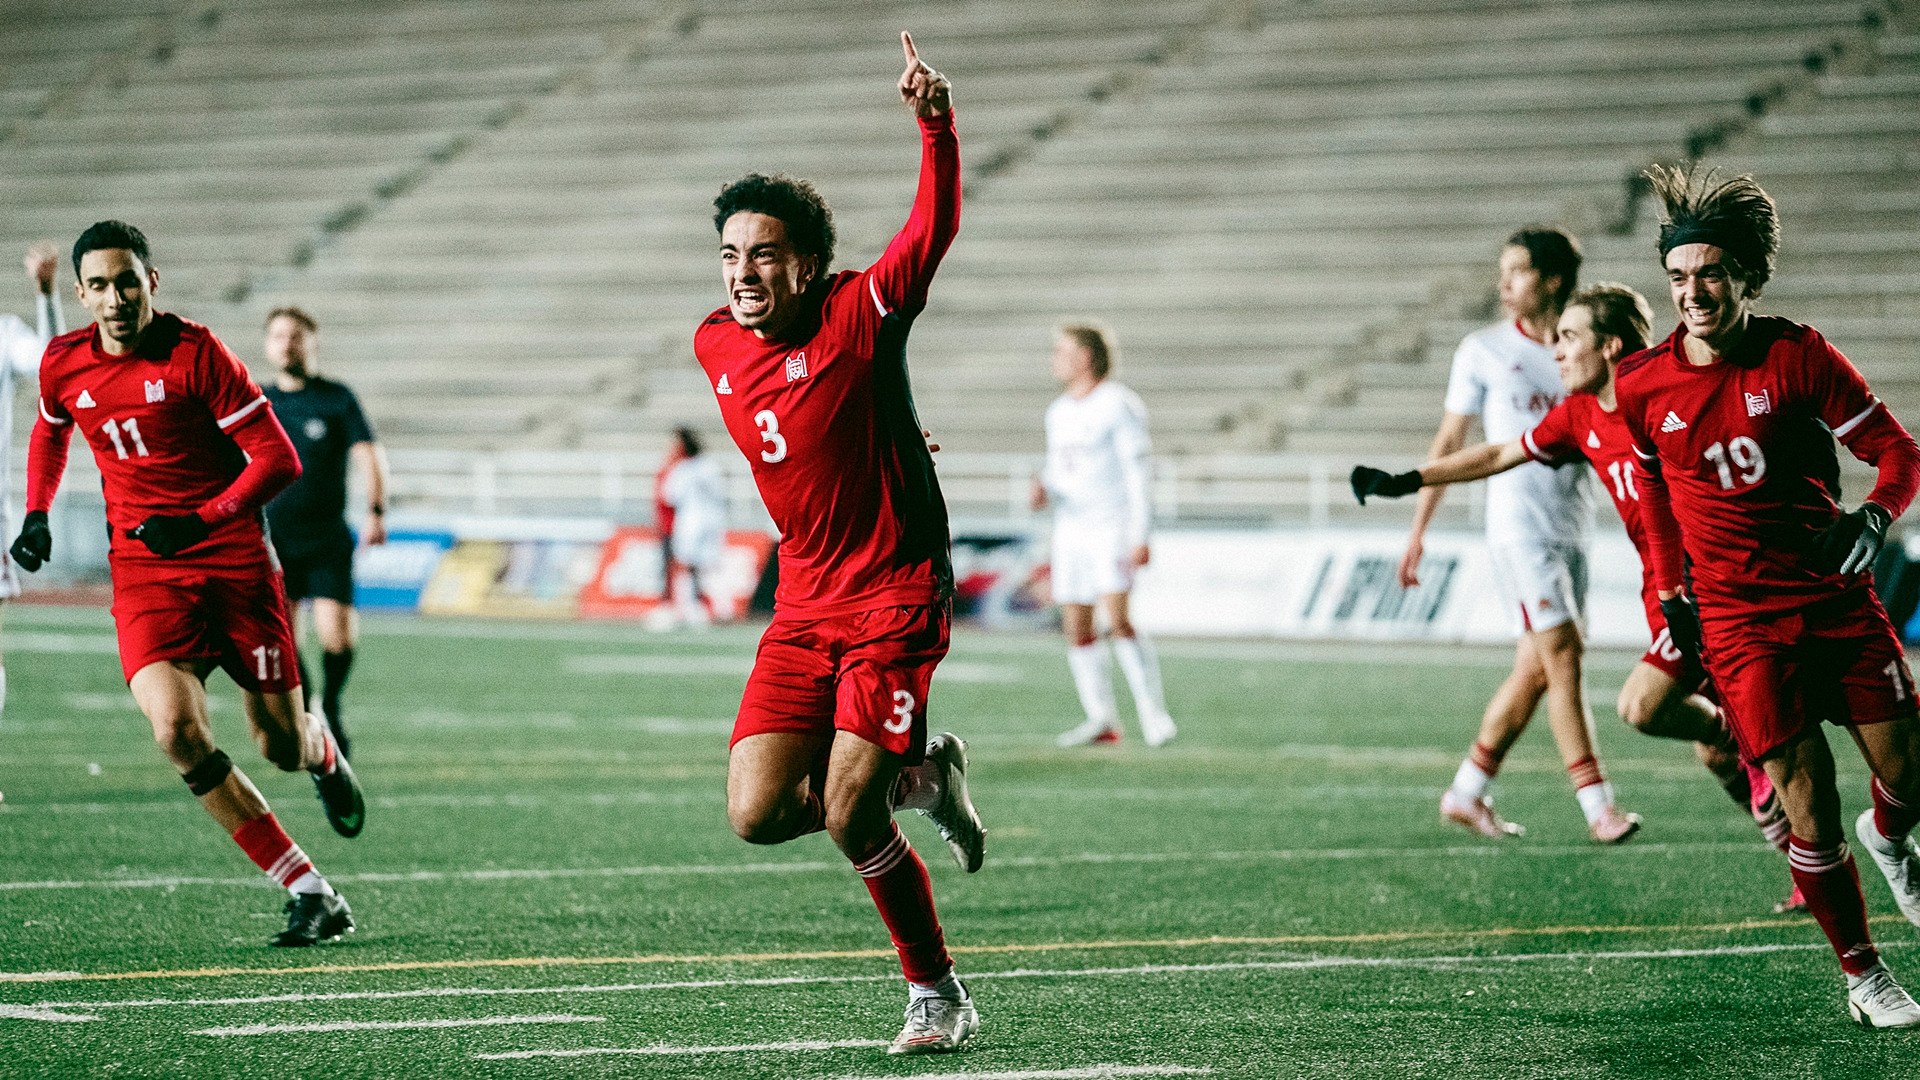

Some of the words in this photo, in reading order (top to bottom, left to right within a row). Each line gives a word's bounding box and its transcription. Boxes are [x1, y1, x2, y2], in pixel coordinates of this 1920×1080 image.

[1511, 391, 1560, 412] LAV
[101, 417, 149, 461] 11
[753, 409, 788, 464] 3
[1703, 435, 1767, 491] 19
[251, 645, 281, 681] 11
[1882, 660, 1910, 701] 1
[882, 689, 916, 736] 3
